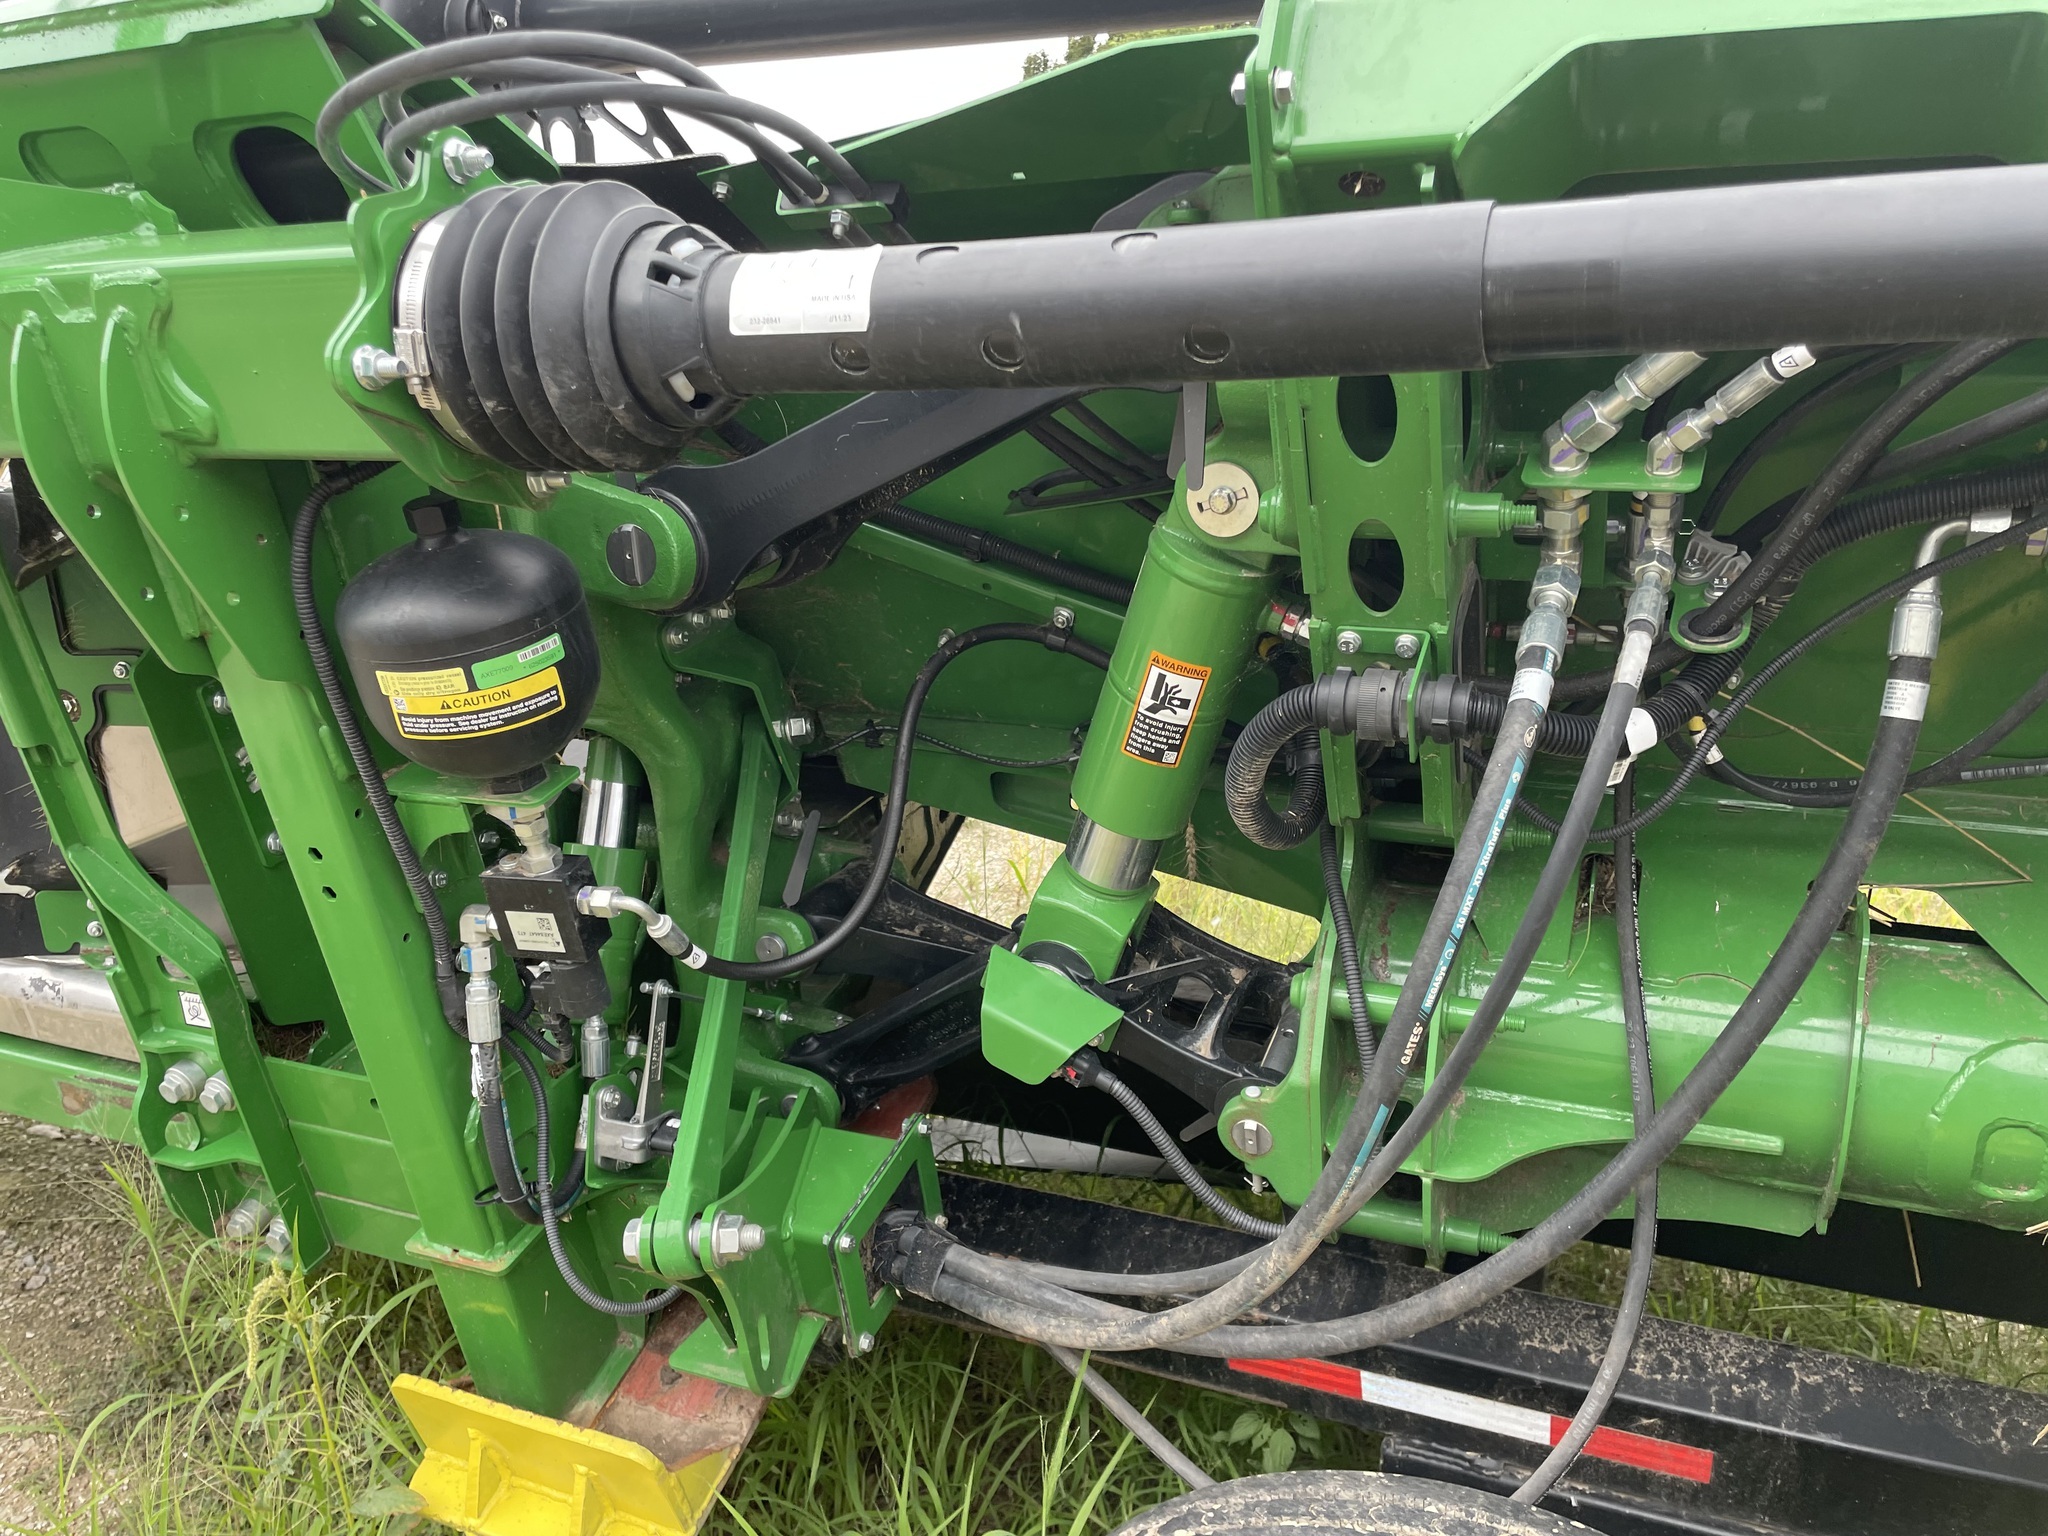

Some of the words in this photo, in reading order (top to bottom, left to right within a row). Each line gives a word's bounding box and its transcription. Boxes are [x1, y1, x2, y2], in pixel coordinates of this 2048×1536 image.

[1161, 658, 1208, 678] WARNING
[401, 715, 416, 723] Avoid
[450, 714, 478, 722] machine
[478, 706, 512, 718] movement
[512, 702, 524, 711] and
[524, 692, 550, 706] exposure
[453, 688, 511, 708] CAUTION
[470, 717, 489, 725] dealer
[498, 707, 530, 720] instruction
[537, 694, 558, 708] relieving
[449, 724, 479, 733] servicing
[479, 720, 504, 730] system.
[1134, 719, 1149, 731] from
[1137, 713, 1144, 721] To
[1145, 718, 1164, 728] avoid
[1164, 723, 1185, 733] injury
[1130, 732, 1152, 746] fingers
[1152, 742, 1169, 751] away
[1132, 726, 1147, 737] keep
[1147, 732, 1167, 743] hands
[1125, 745, 1141, 756] area.
[1128, 738, 1143, 749] from
[1143, 745, 1155, 754] this
[1400, 1023, 1424, 1065] GATES
[1456, 916, 1466, 930] 10
[1472, 868, 1485, 888] XTP
[1498, 798, 1512, 821] Plus
